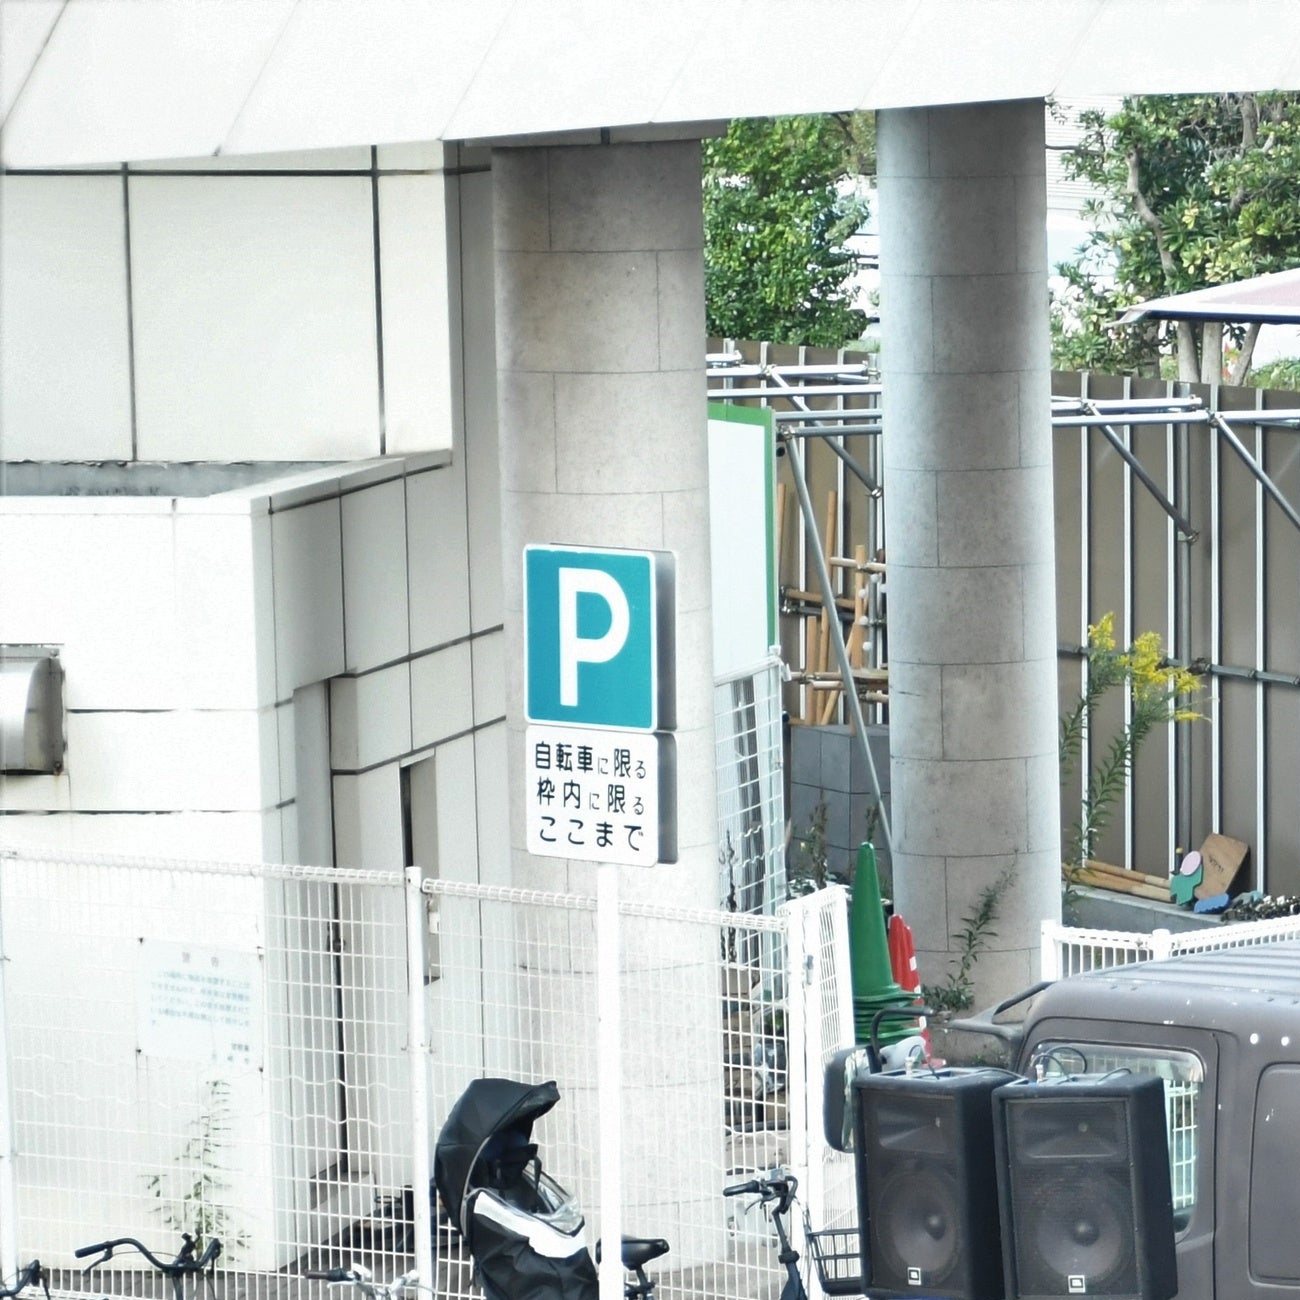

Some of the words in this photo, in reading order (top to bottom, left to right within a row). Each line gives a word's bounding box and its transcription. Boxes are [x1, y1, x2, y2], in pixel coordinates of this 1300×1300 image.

[559, 567, 630, 706] P
[534, 741, 647, 780] 自転車に限る
[536, 777, 645, 816] 枠内に限る
[539, 816, 644, 852] ここまで
